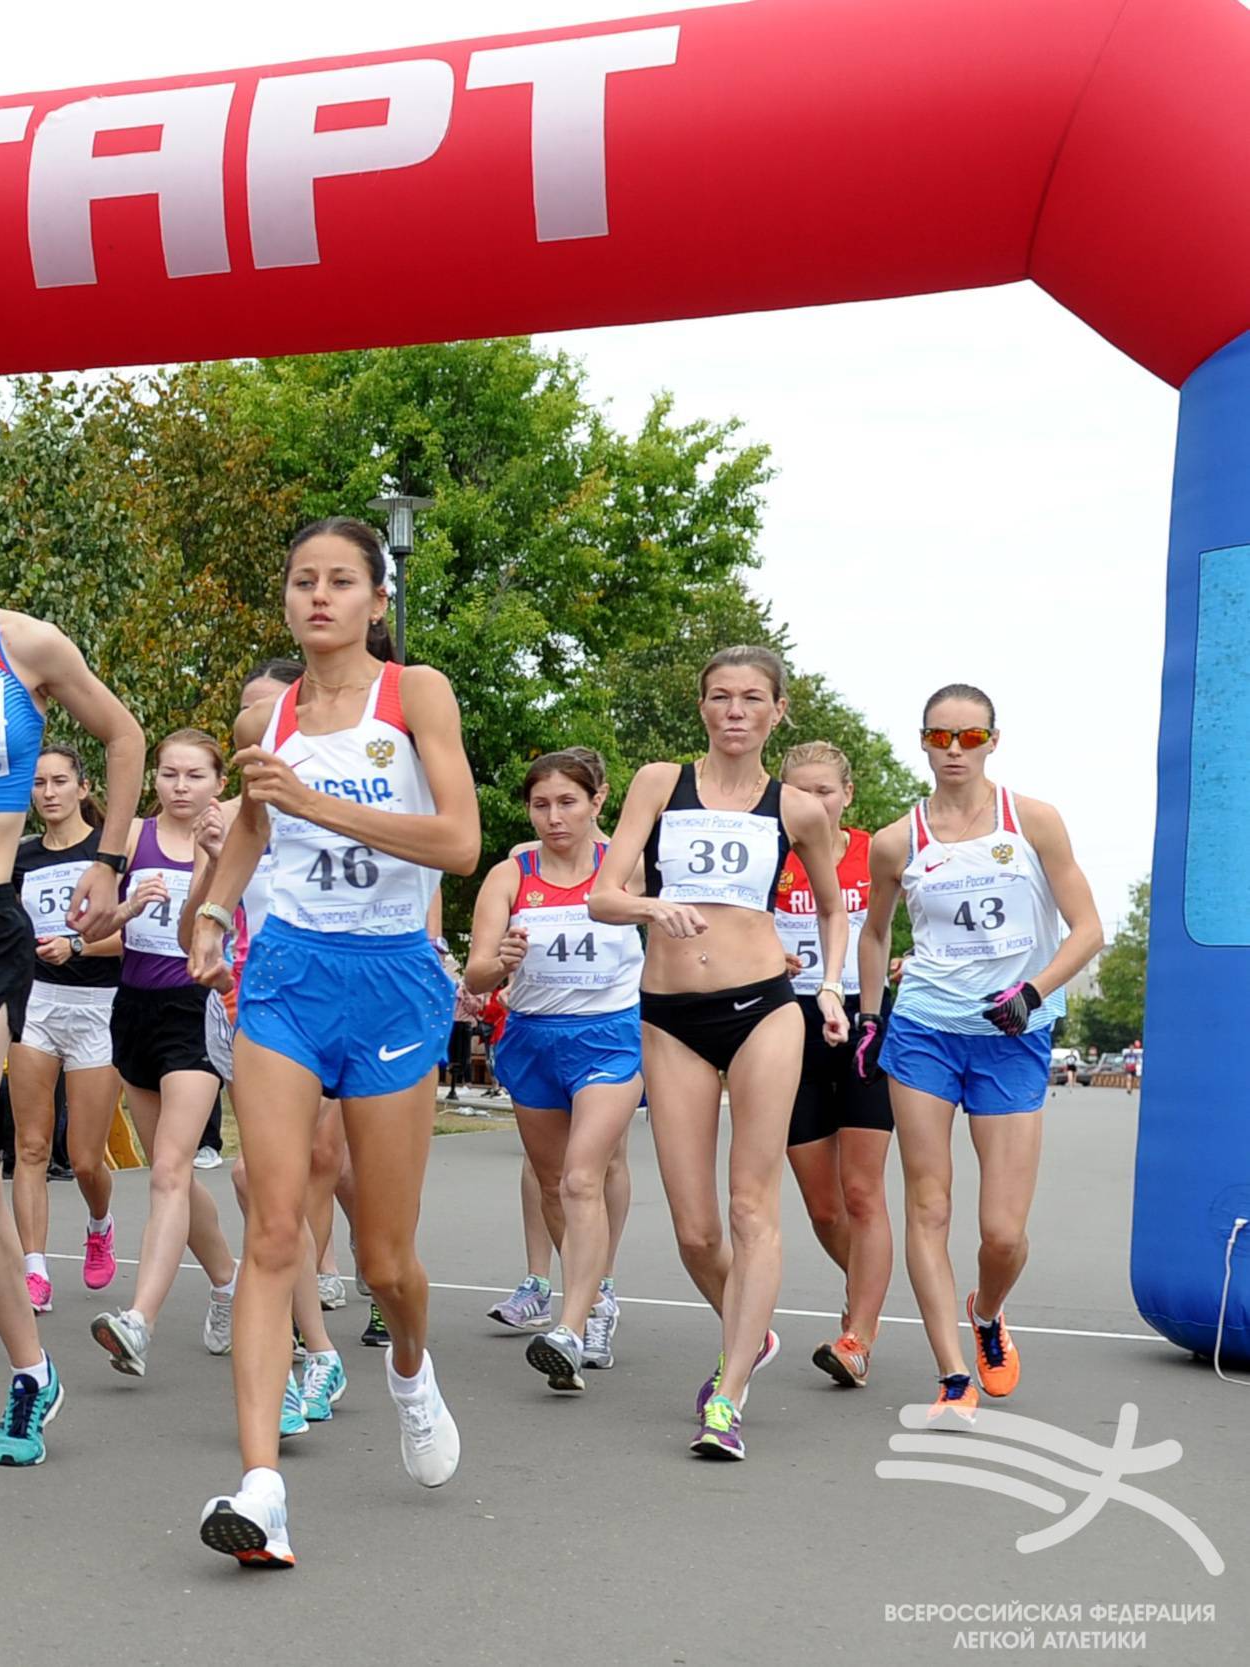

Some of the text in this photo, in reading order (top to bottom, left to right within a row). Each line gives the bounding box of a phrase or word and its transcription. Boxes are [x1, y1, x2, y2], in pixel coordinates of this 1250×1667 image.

[314, 777, 394, 804] SSIA
[306, 845, 379, 892] 46
[688, 839, 749, 874] 39
[39, 886, 75, 914] 53
[149, 897, 186, 927] 4
[788, 888, 862, 913] RUIA
[953, 897, 1006, 932] 43
[546, 931, 598, 962] 44
